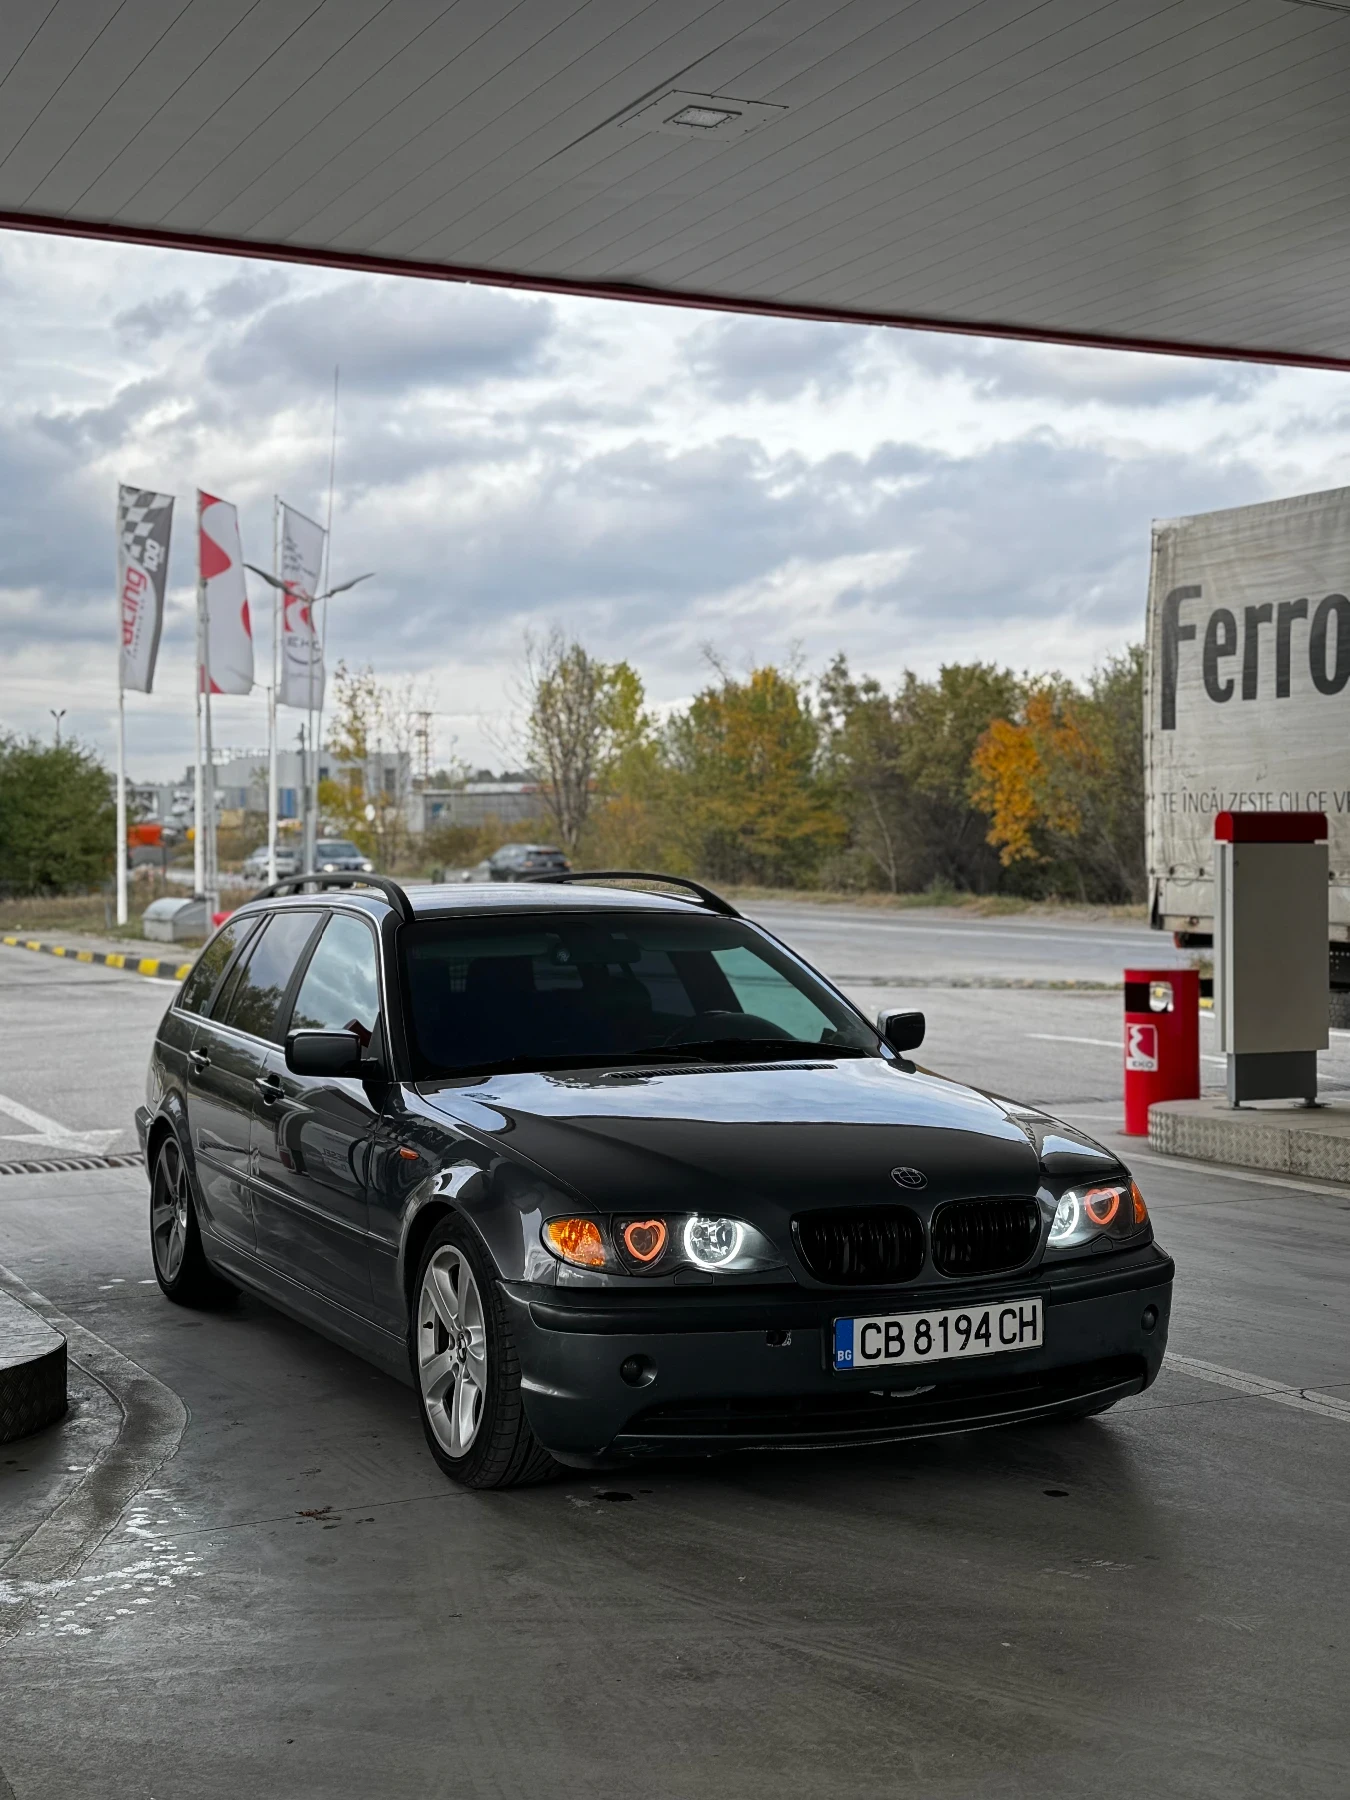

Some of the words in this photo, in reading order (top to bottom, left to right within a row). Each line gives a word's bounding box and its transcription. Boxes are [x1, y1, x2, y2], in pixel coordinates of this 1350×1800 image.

[143, 538, 160, 572] 100
[1161, 792, 1177, 813] TE
[1306, 791, 1328, 813] CE
[860, 1321, 905, 1360] CB
[914, 1311, 991, 1355] 8194
[998, 1305, 1037, 1345] CH
[837, 1349, 852, 1362] BG
